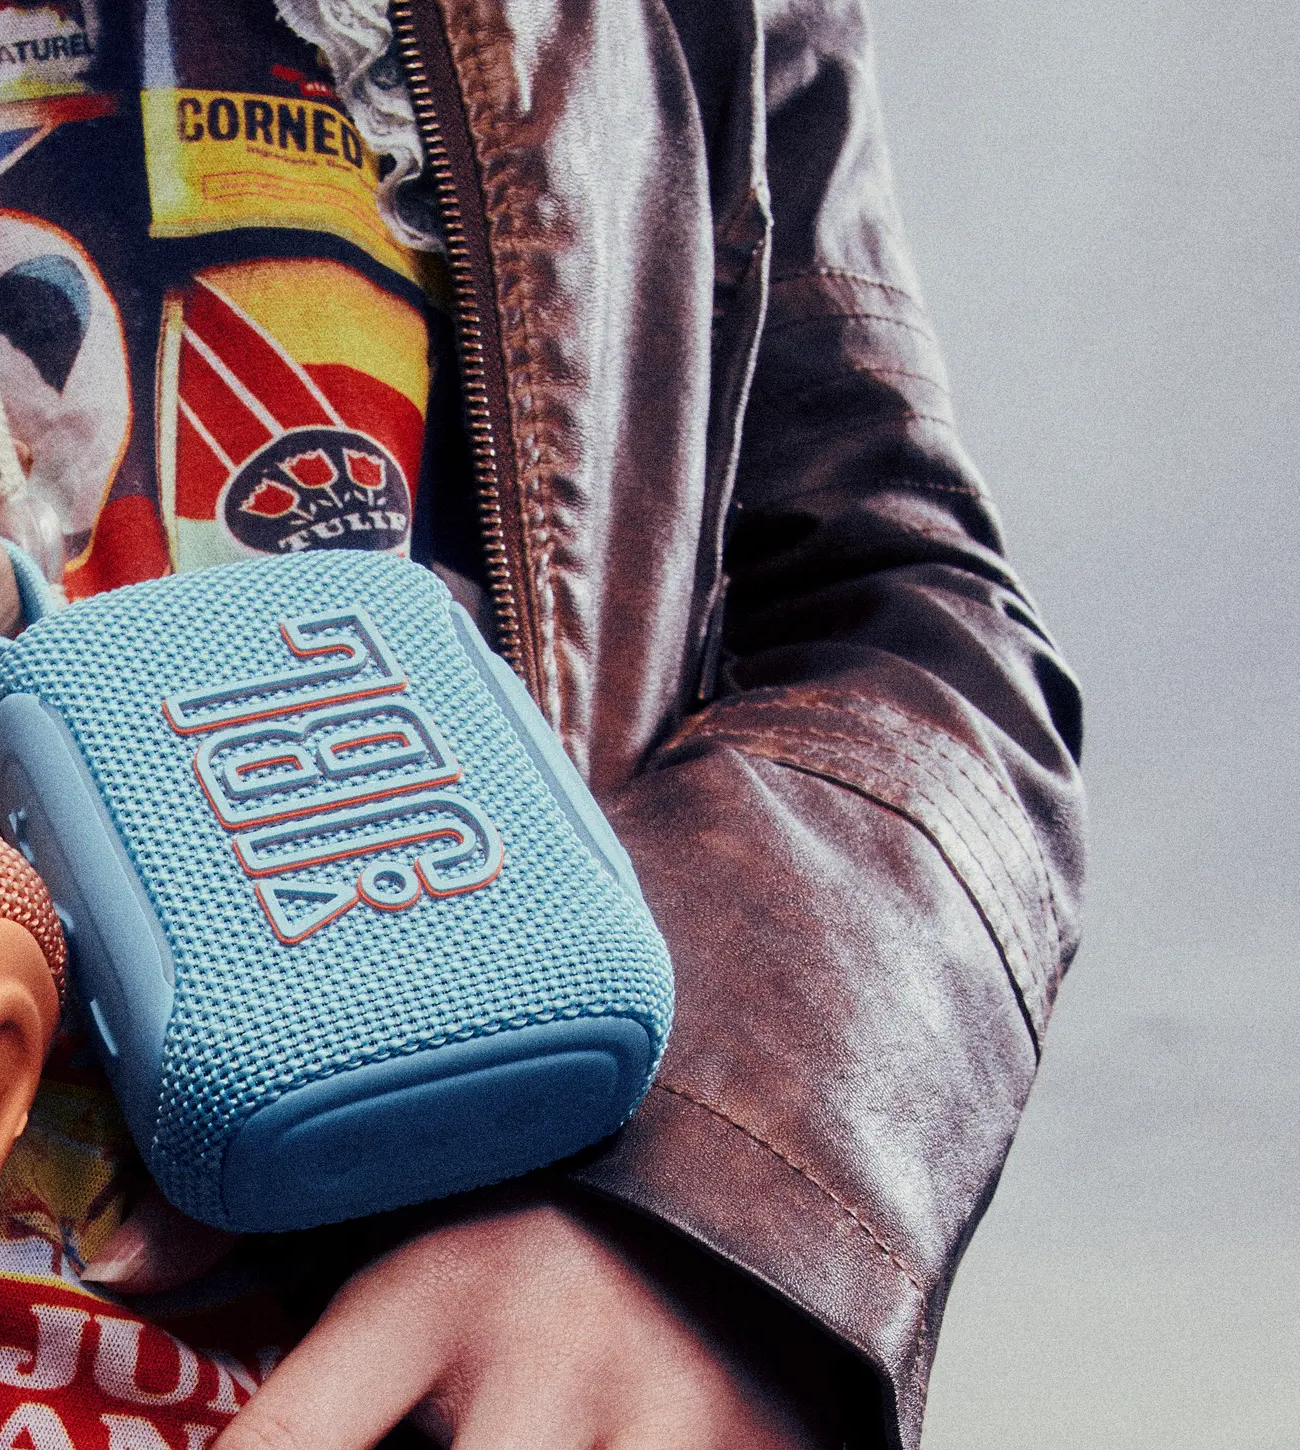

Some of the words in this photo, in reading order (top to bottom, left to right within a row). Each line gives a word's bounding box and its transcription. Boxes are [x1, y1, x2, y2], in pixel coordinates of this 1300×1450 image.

[178, 97, 363, 170] CORNED
[277, 509, 408, 552] TULIP
[162, 605, 505, 945] JBL
